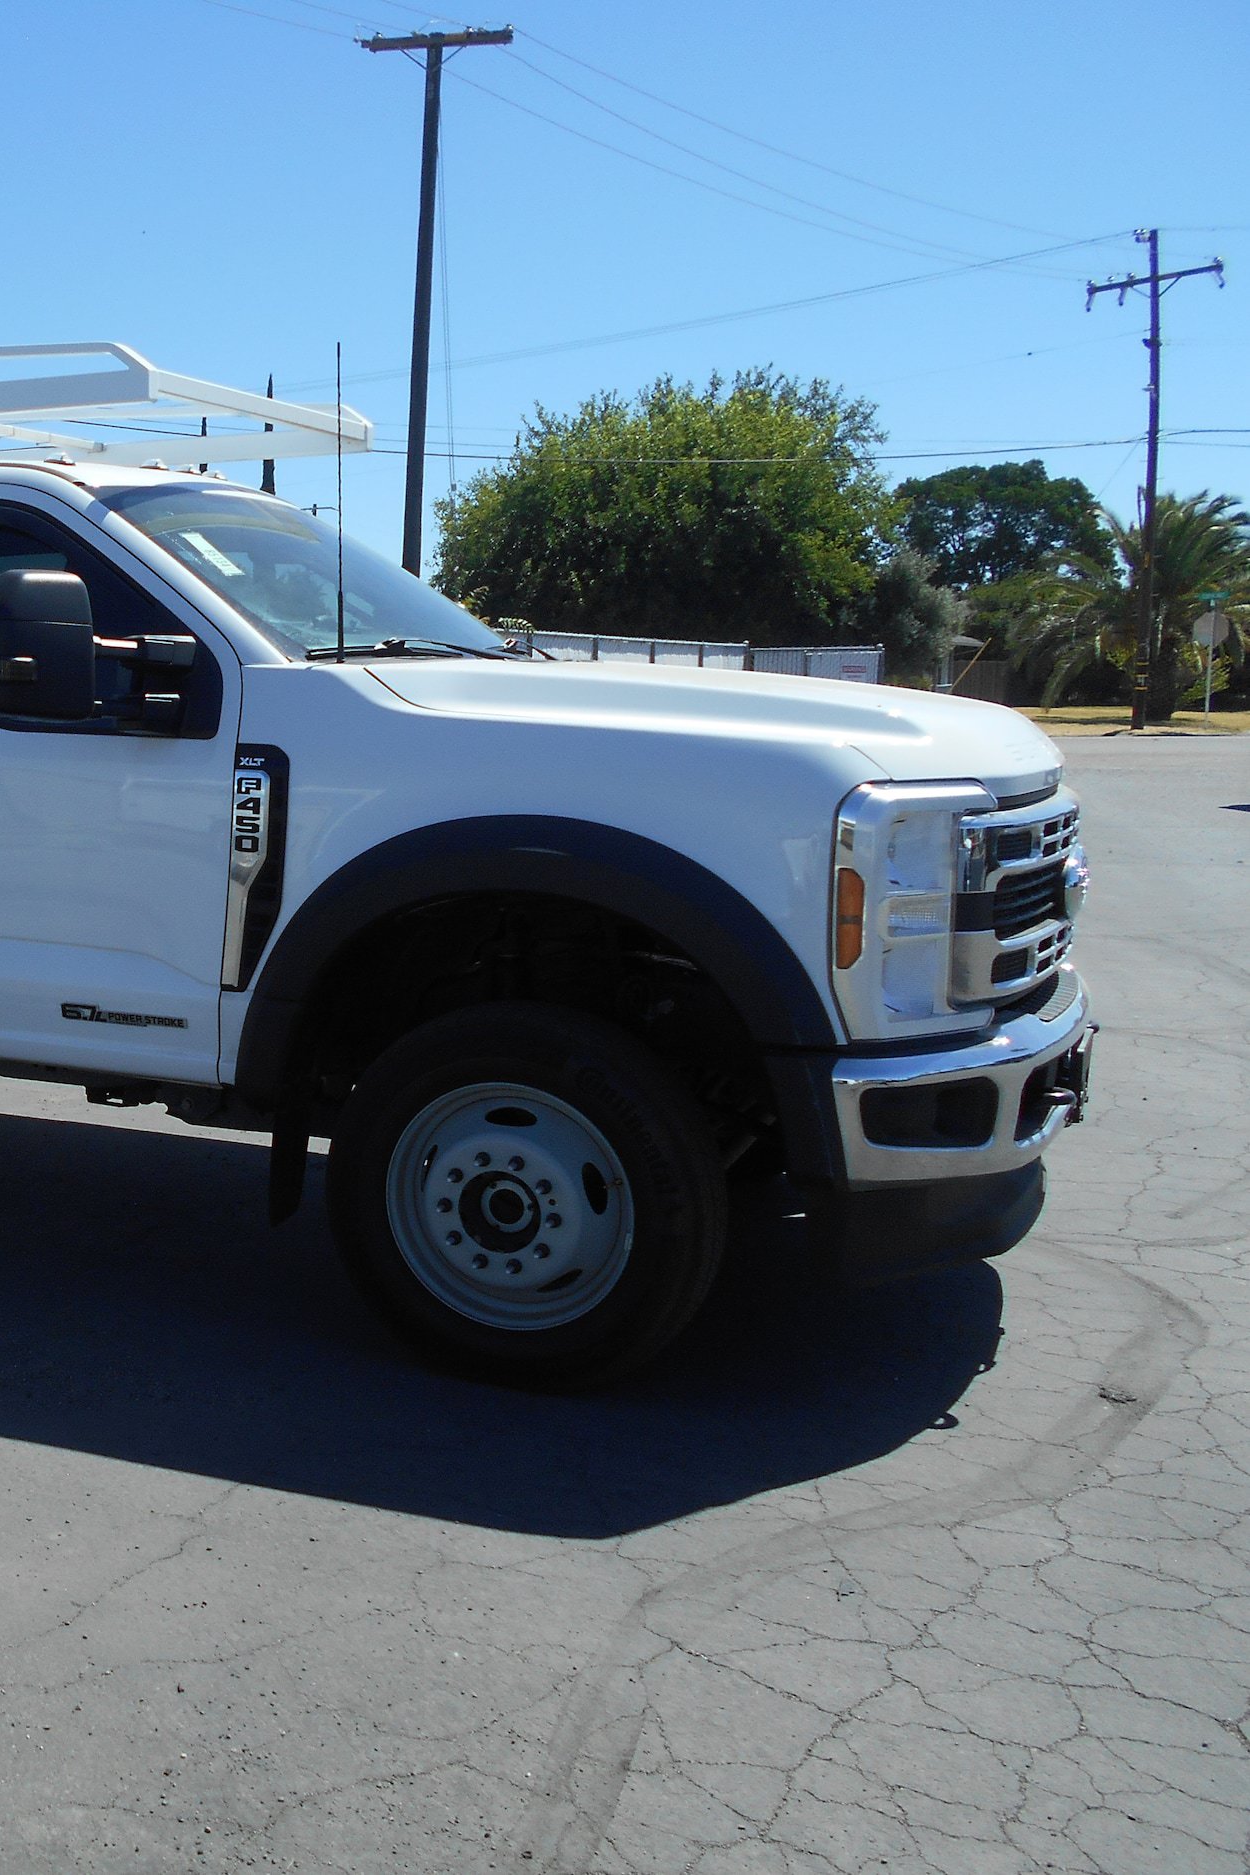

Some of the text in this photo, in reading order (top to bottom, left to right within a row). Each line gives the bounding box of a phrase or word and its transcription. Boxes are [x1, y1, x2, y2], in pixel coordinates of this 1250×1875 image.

[239, 757, 265, 767] XLT
[235, 777, 261, 852] F450
[108, 1012, 143, 1023] POWER
[144, 1016, 185, 1028] STROKE
